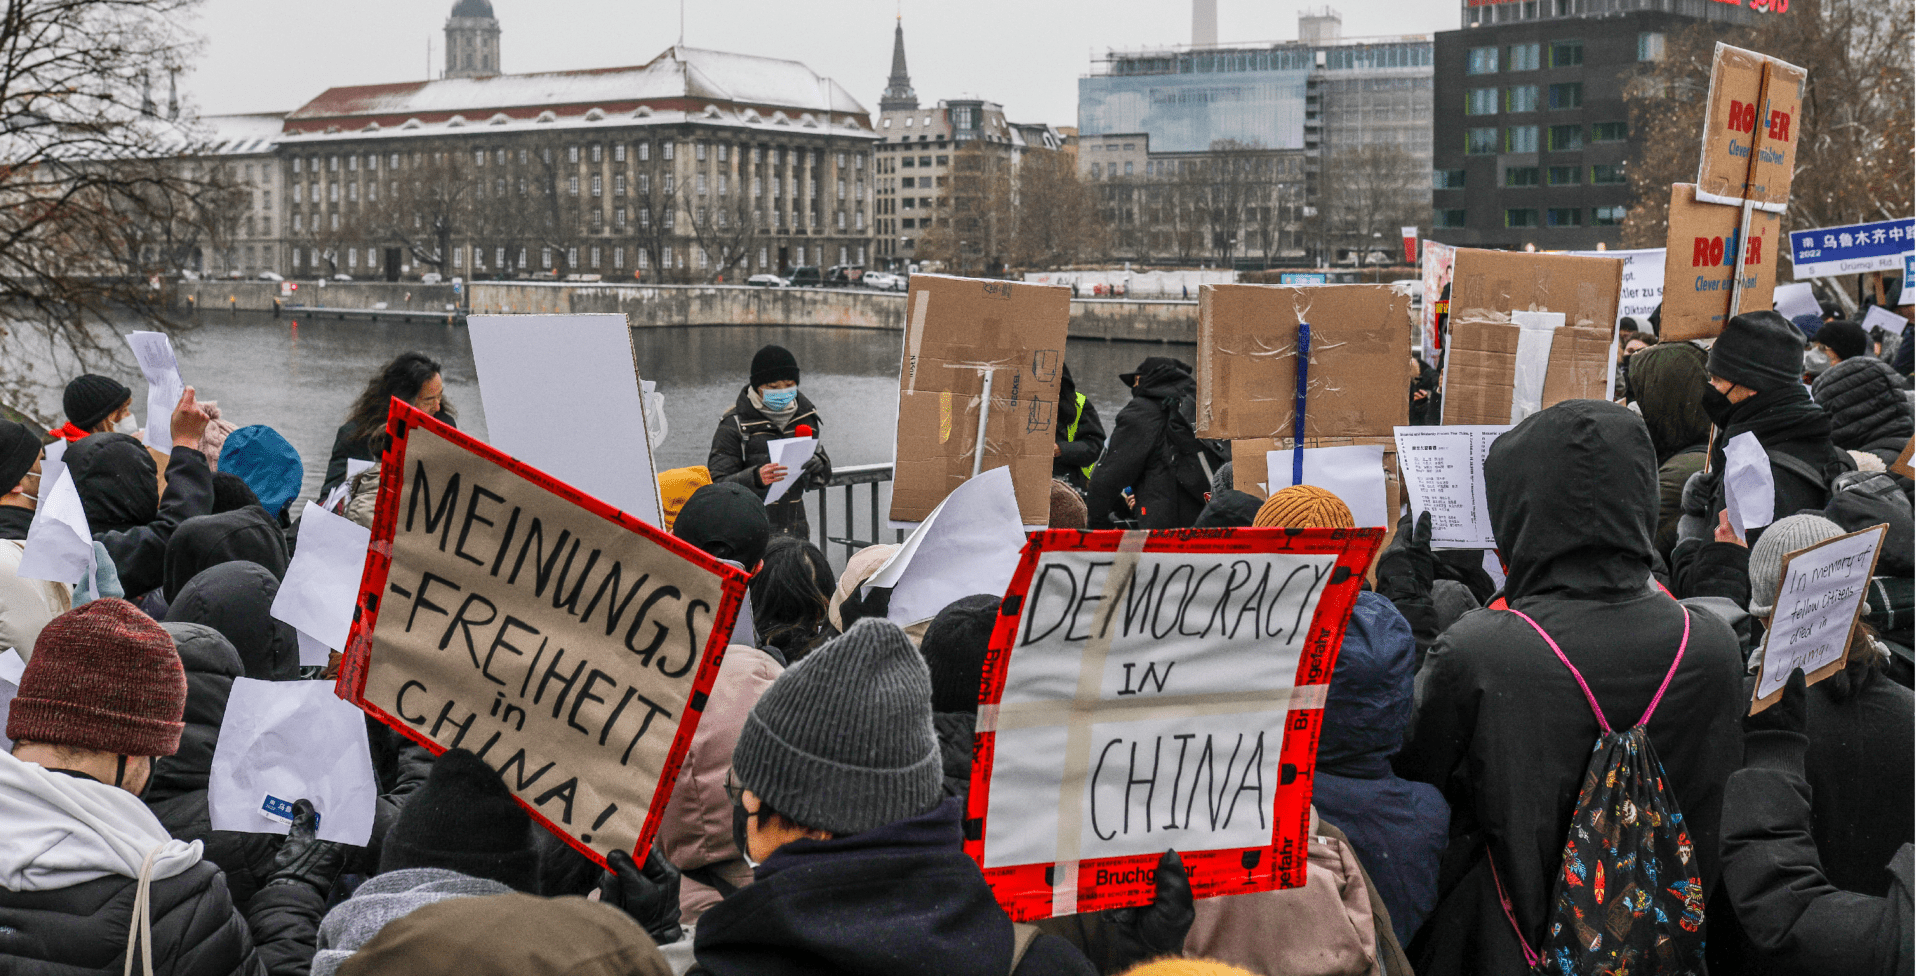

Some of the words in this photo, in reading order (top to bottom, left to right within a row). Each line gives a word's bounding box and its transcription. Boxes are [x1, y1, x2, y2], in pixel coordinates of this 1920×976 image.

[1728, 138, 1750, 158] Clever
[1799, 249, 1821, 259] 2022
[1642, 288, 1654, 298] zu
[1695, 275, 1720, 292] Clever
[406, 459, 711, 679] MEINUNGS
[1789, 569, 1807, 594] In
[1811, 554, 1857, 583] memory
[1857, 544, 1873, 568] of
[1020, 559, 1334, 647] DEMOCRACY
[1790, 598, 1820, 624] fellow
[1789, 622, 1813, 645] died
[1818, 616, 1828, 630] in
[390, 571, 673, 766] -FREIHEIT
[1117, 661, 1176, 696] IN
[490, 690, 527, 732] in
[396, 679, 619, 844] CHINA!
[1091, 731, 1266, 841] CHINA
